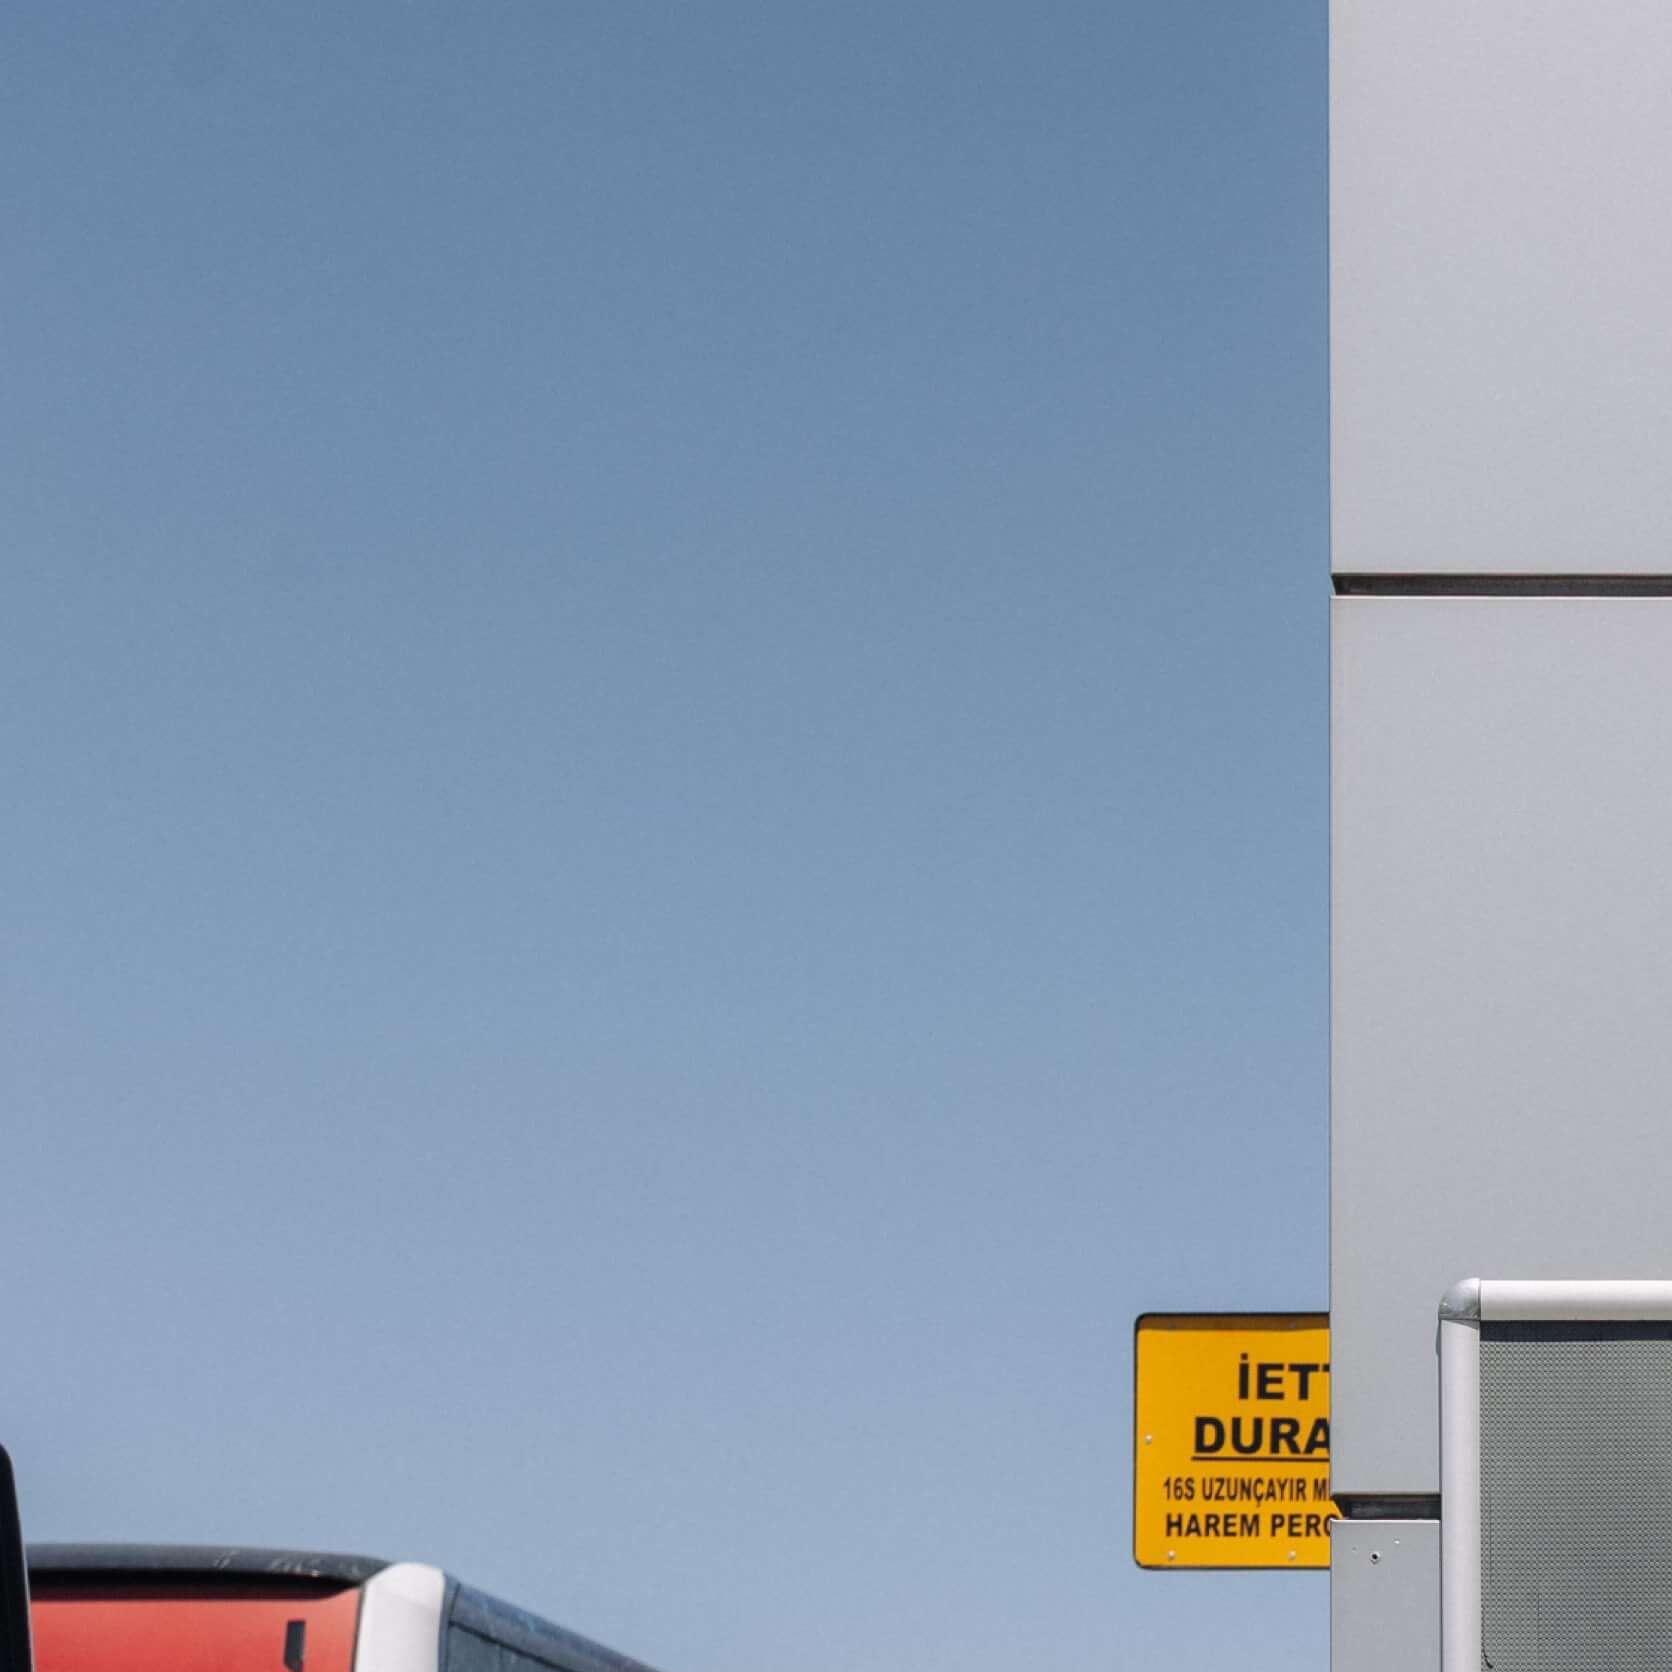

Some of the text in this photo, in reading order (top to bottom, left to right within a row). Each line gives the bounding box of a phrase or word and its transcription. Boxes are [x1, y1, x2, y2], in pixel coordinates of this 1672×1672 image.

[1194, 1416, 1330, 1454] DURA
[1202, 1477, 1307, 1508] UZUNÇAYIR
[1313, 1477, 1331, 1501] M
[1165, 1513, 1260, 1537] HAREM
